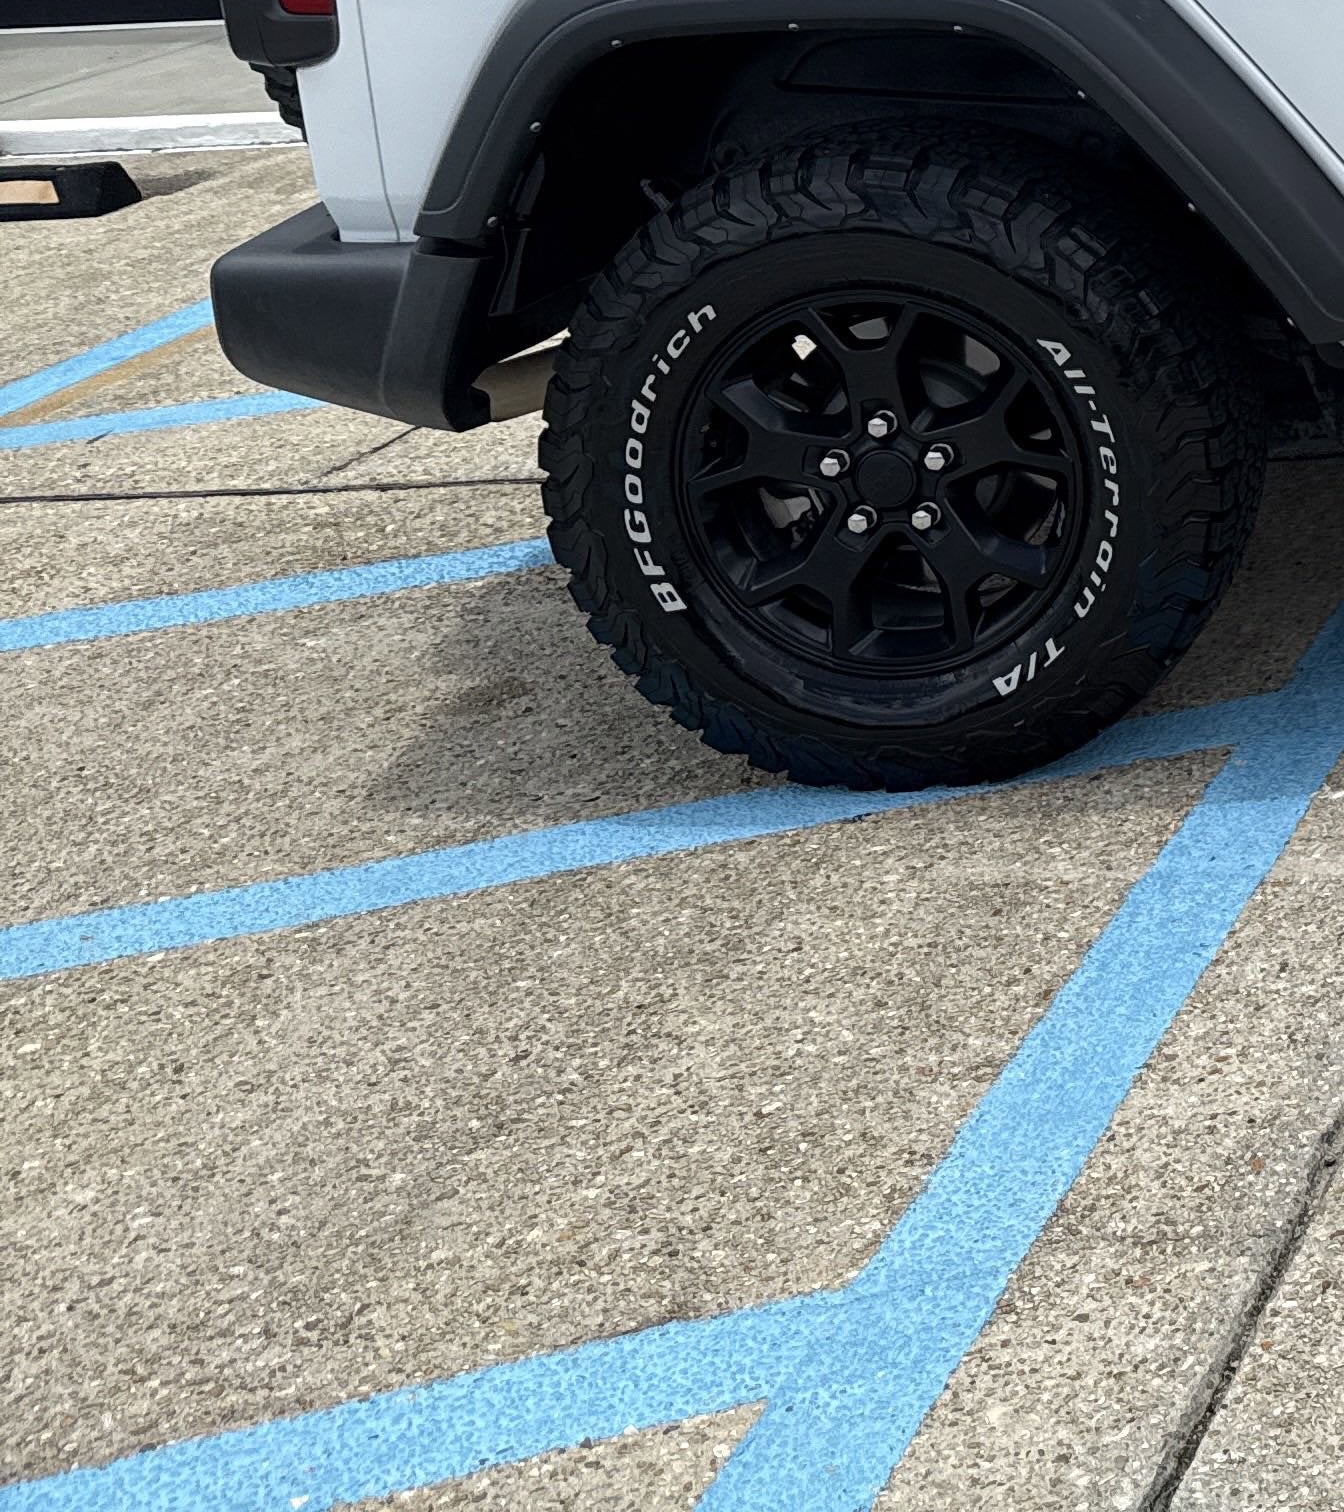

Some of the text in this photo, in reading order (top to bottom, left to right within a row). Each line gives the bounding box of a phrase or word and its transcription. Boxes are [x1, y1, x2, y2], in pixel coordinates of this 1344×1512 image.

[624, 304, 717, 612] BFGoodrich
[992, 337, 1119, 696] All-Terrain T/A
